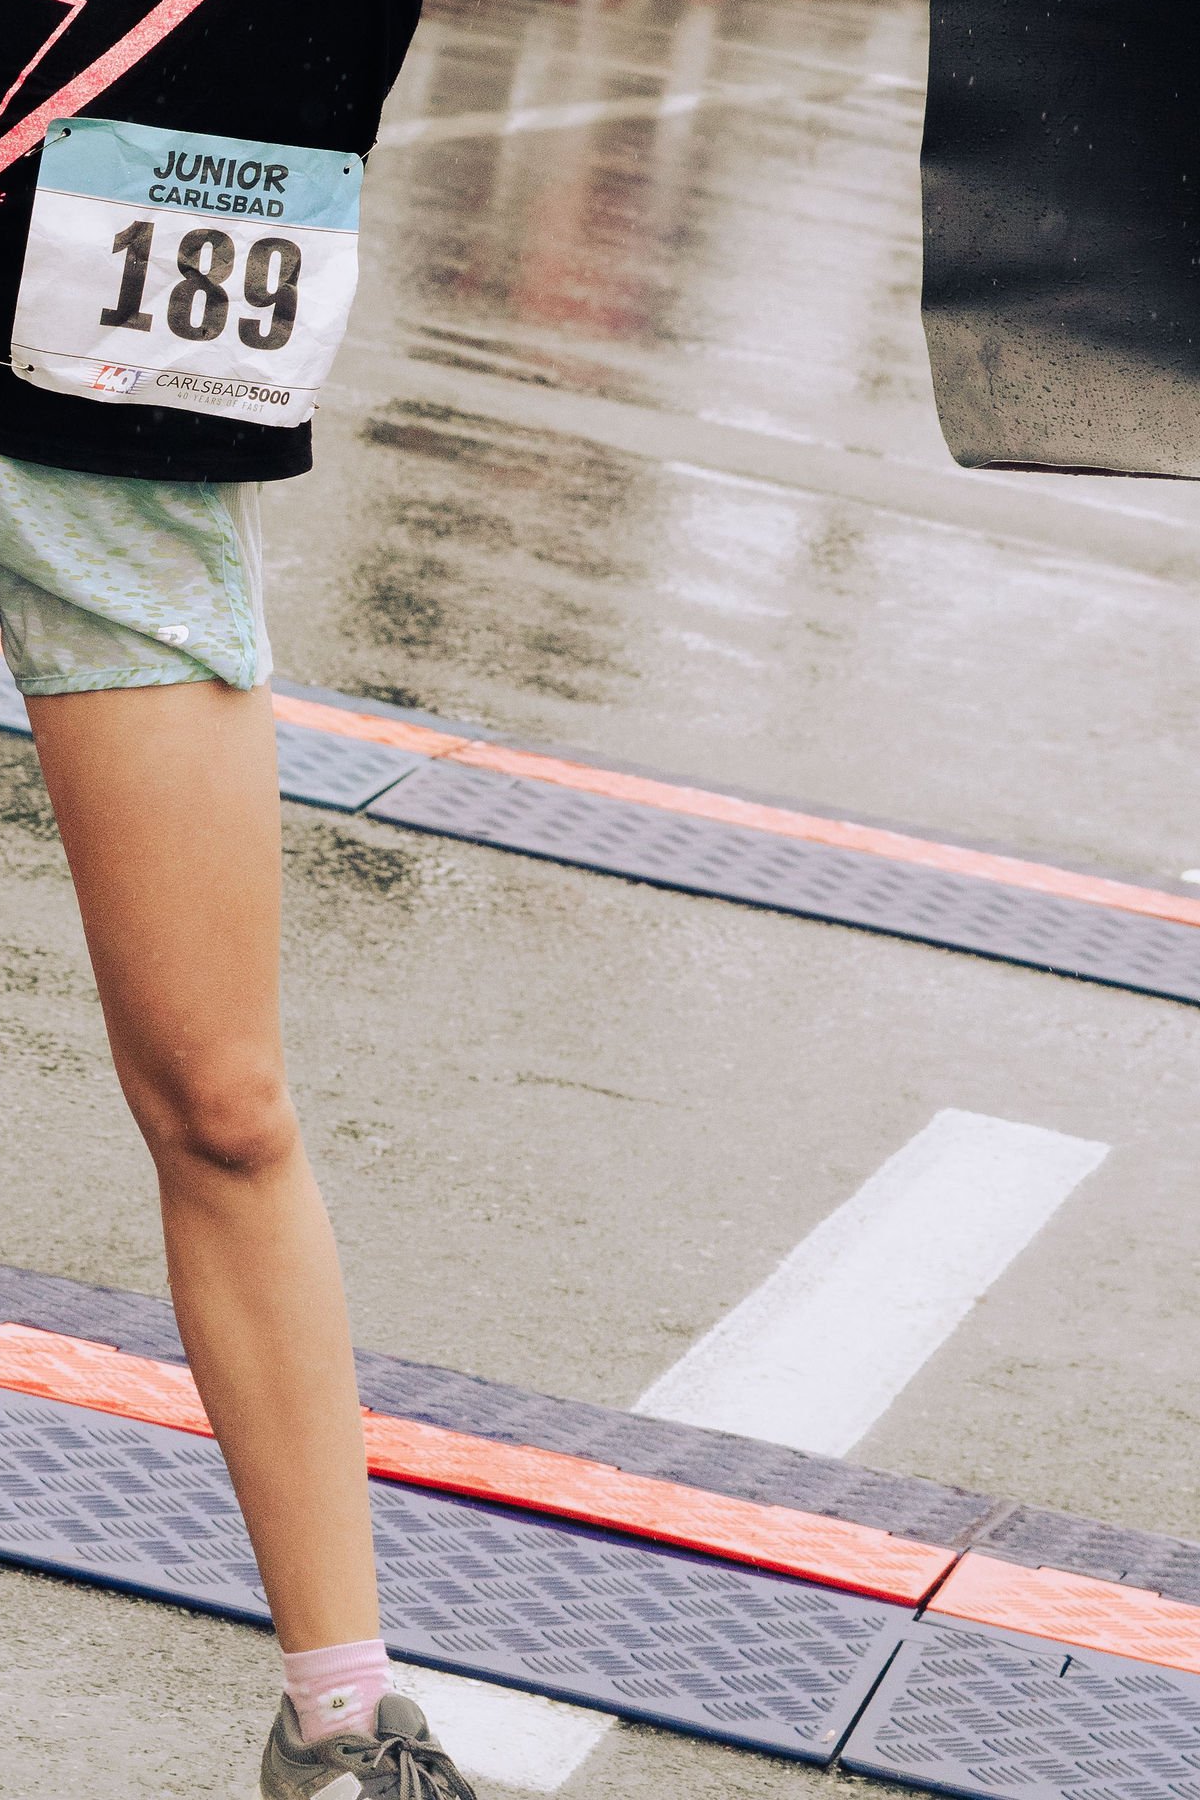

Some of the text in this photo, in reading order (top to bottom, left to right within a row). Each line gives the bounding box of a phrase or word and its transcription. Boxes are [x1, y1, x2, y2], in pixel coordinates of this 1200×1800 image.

[153, 151, 289, 194] JUNIOR
[148, 184, 284, 218] CARLSBAD
[100, 220, 302, 350] 189
[156, 374, 290, 406] CARLSBAD5000
[193, 394, 223, 406] YEARS
[226, 399, 239, 408] OF
[242, 401, 265, 413] FAST
